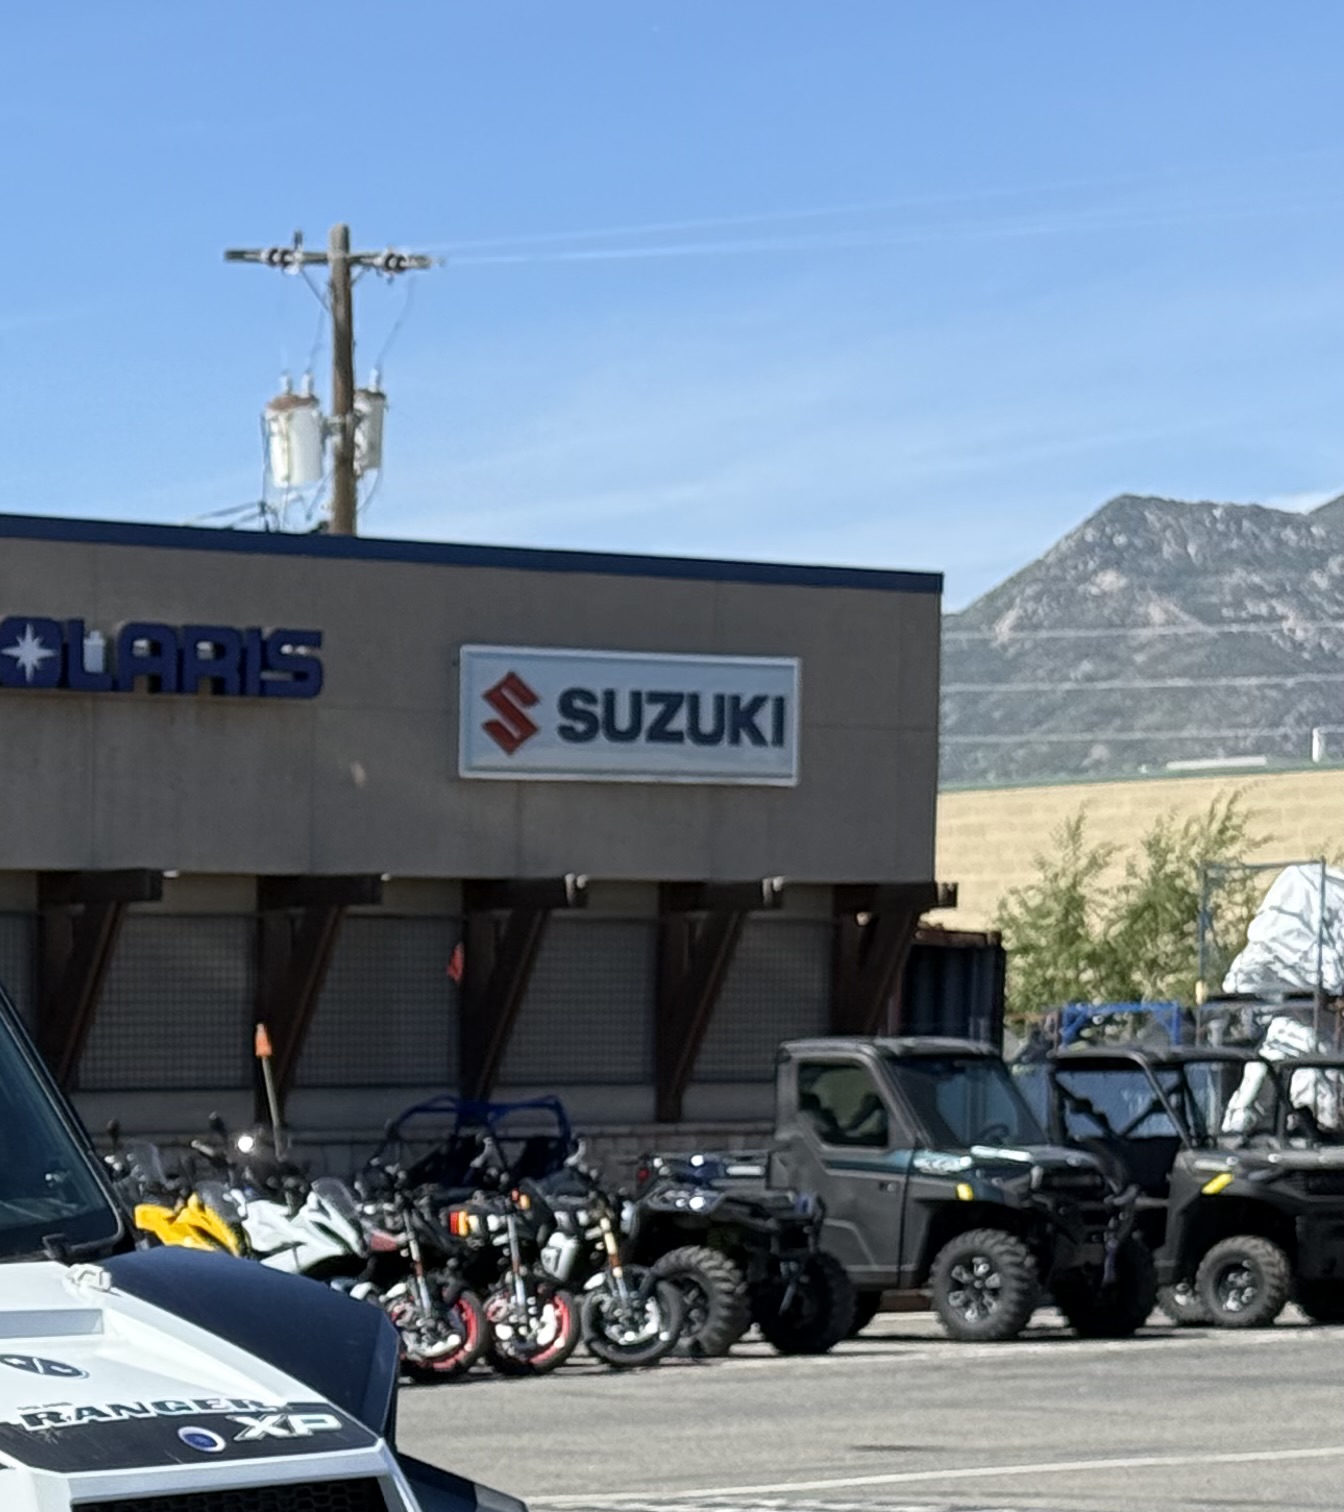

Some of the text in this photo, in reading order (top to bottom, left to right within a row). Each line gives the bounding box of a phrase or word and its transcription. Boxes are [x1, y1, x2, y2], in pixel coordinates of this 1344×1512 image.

[556, 686, 786, 748] SUZUKI
[16, 1397, 280, 1432] RANGER
[224, 1413, 343, 1442] XP
